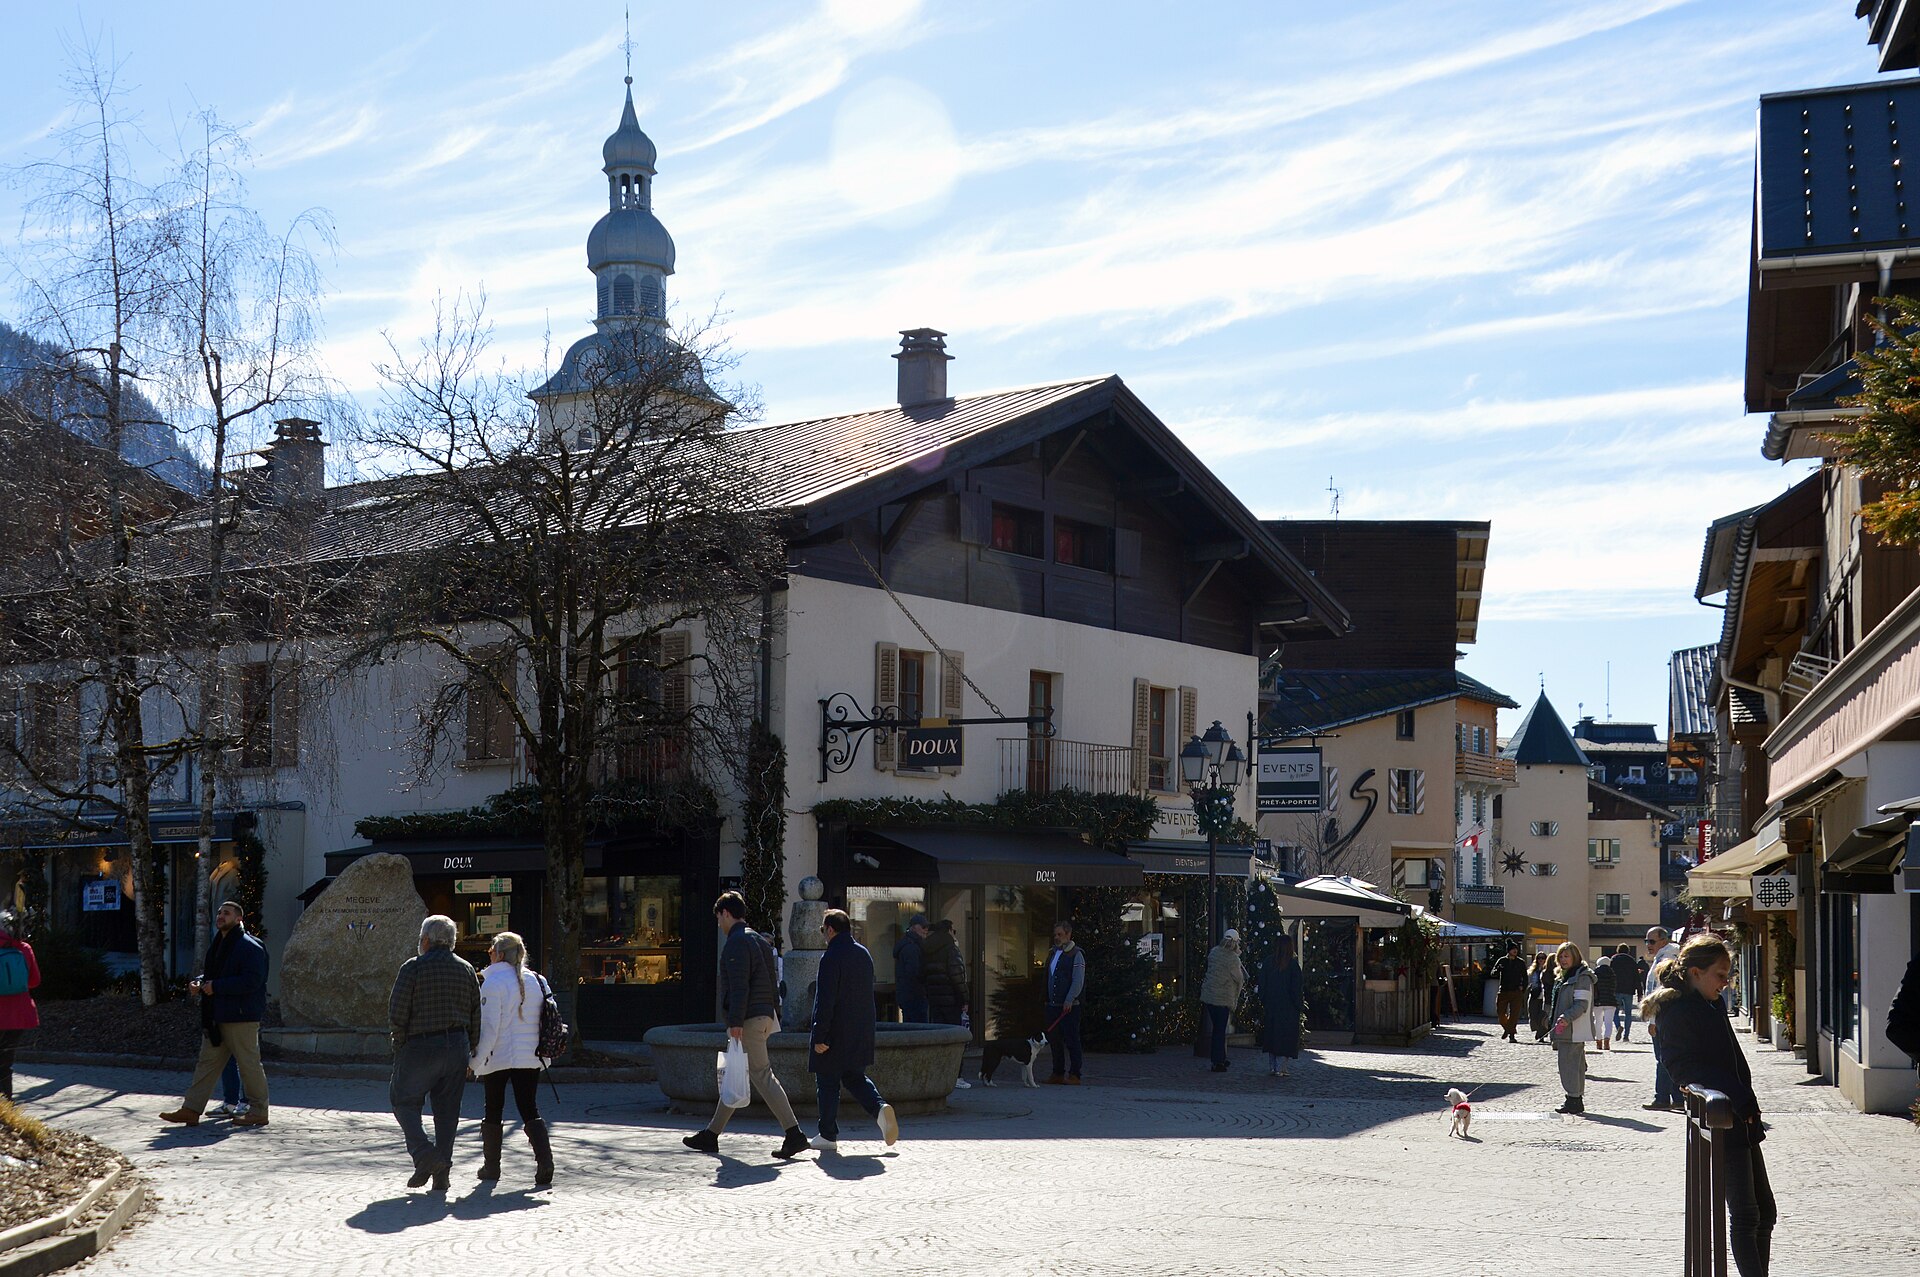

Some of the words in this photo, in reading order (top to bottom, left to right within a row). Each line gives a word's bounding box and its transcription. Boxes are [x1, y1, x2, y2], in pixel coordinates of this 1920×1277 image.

[910, 739, 959, 755] DOUX
[1263, 764, 1314, 773] EVENTS
[1161, 812, 1199, 827] EVENTS
[443, 857, 474, 869] DOUX
[1175, 858, 1193, 867] EVENTS
[1035, 870, 1057, 882] DOUX
